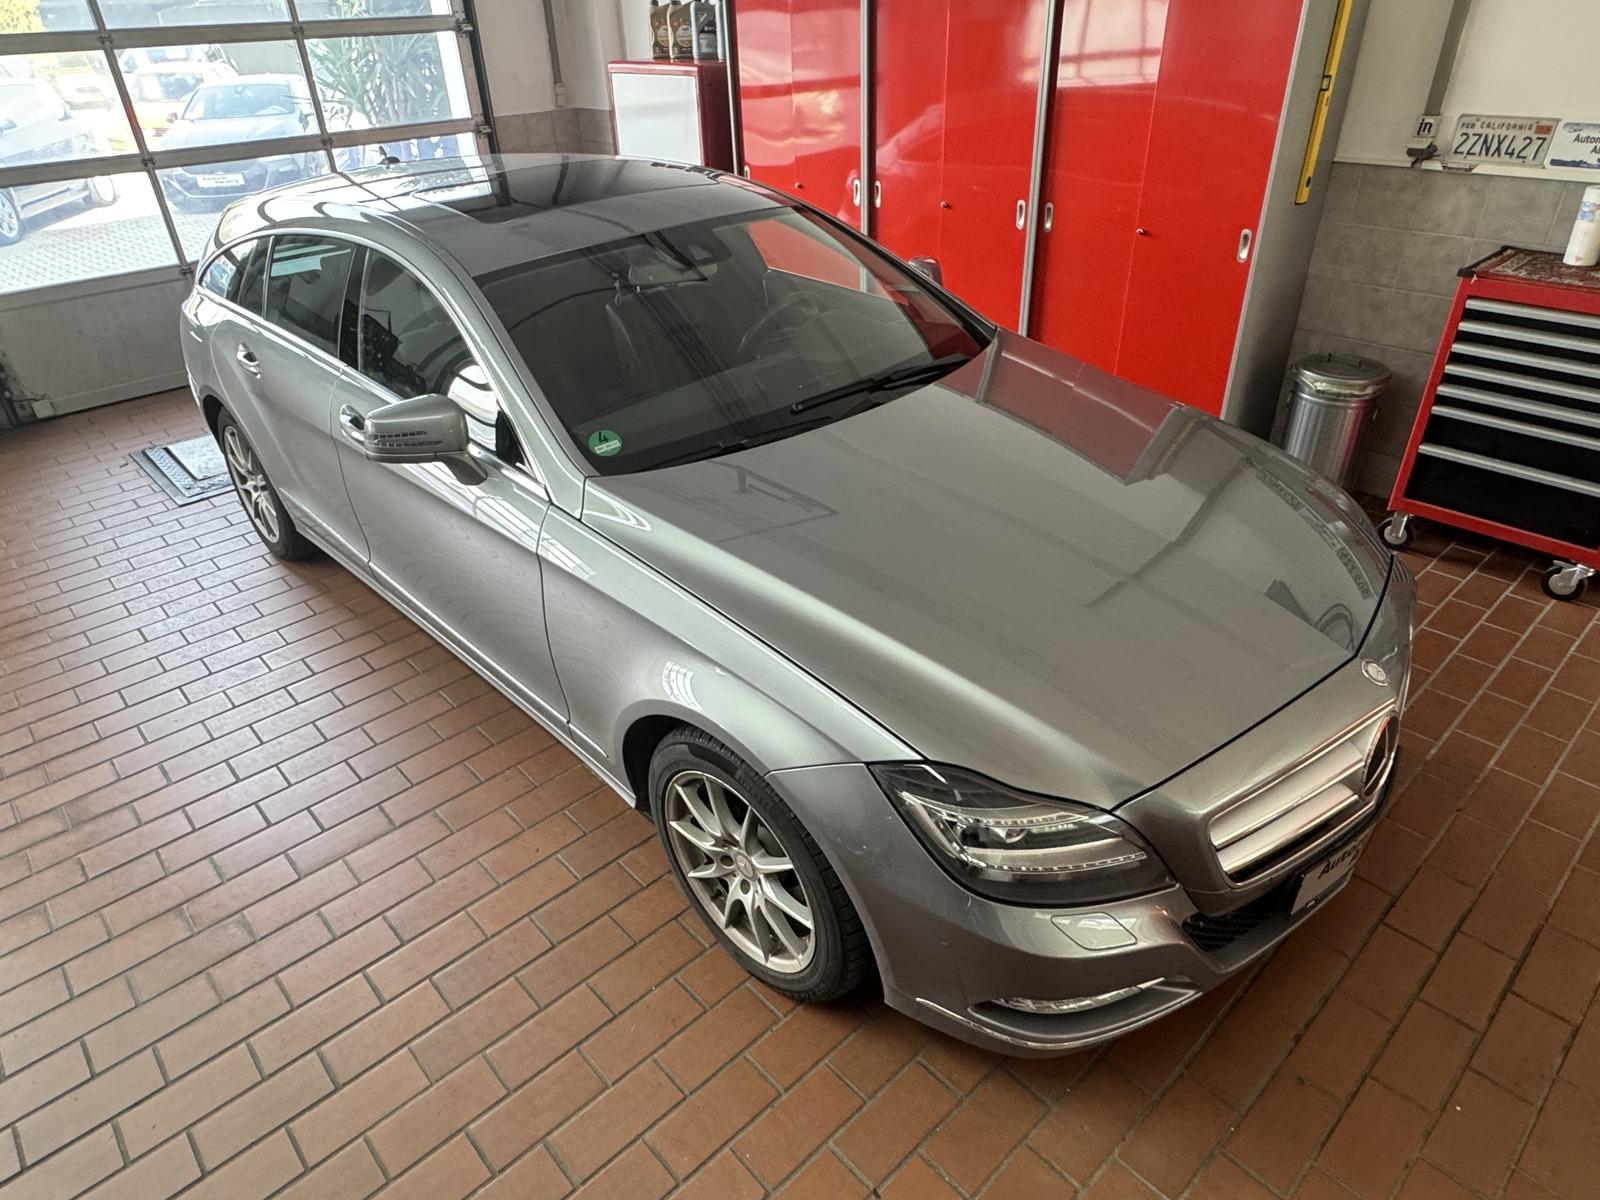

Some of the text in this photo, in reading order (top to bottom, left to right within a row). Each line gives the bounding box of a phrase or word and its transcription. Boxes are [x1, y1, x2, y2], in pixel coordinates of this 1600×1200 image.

[1460, 122, 1475, 130] FEB
[1480, 120, 1534, 132] CALIFORNIA
[1453, 132, 1548, 161] 2ZNX427
[598, 431, 609, 443] 4
